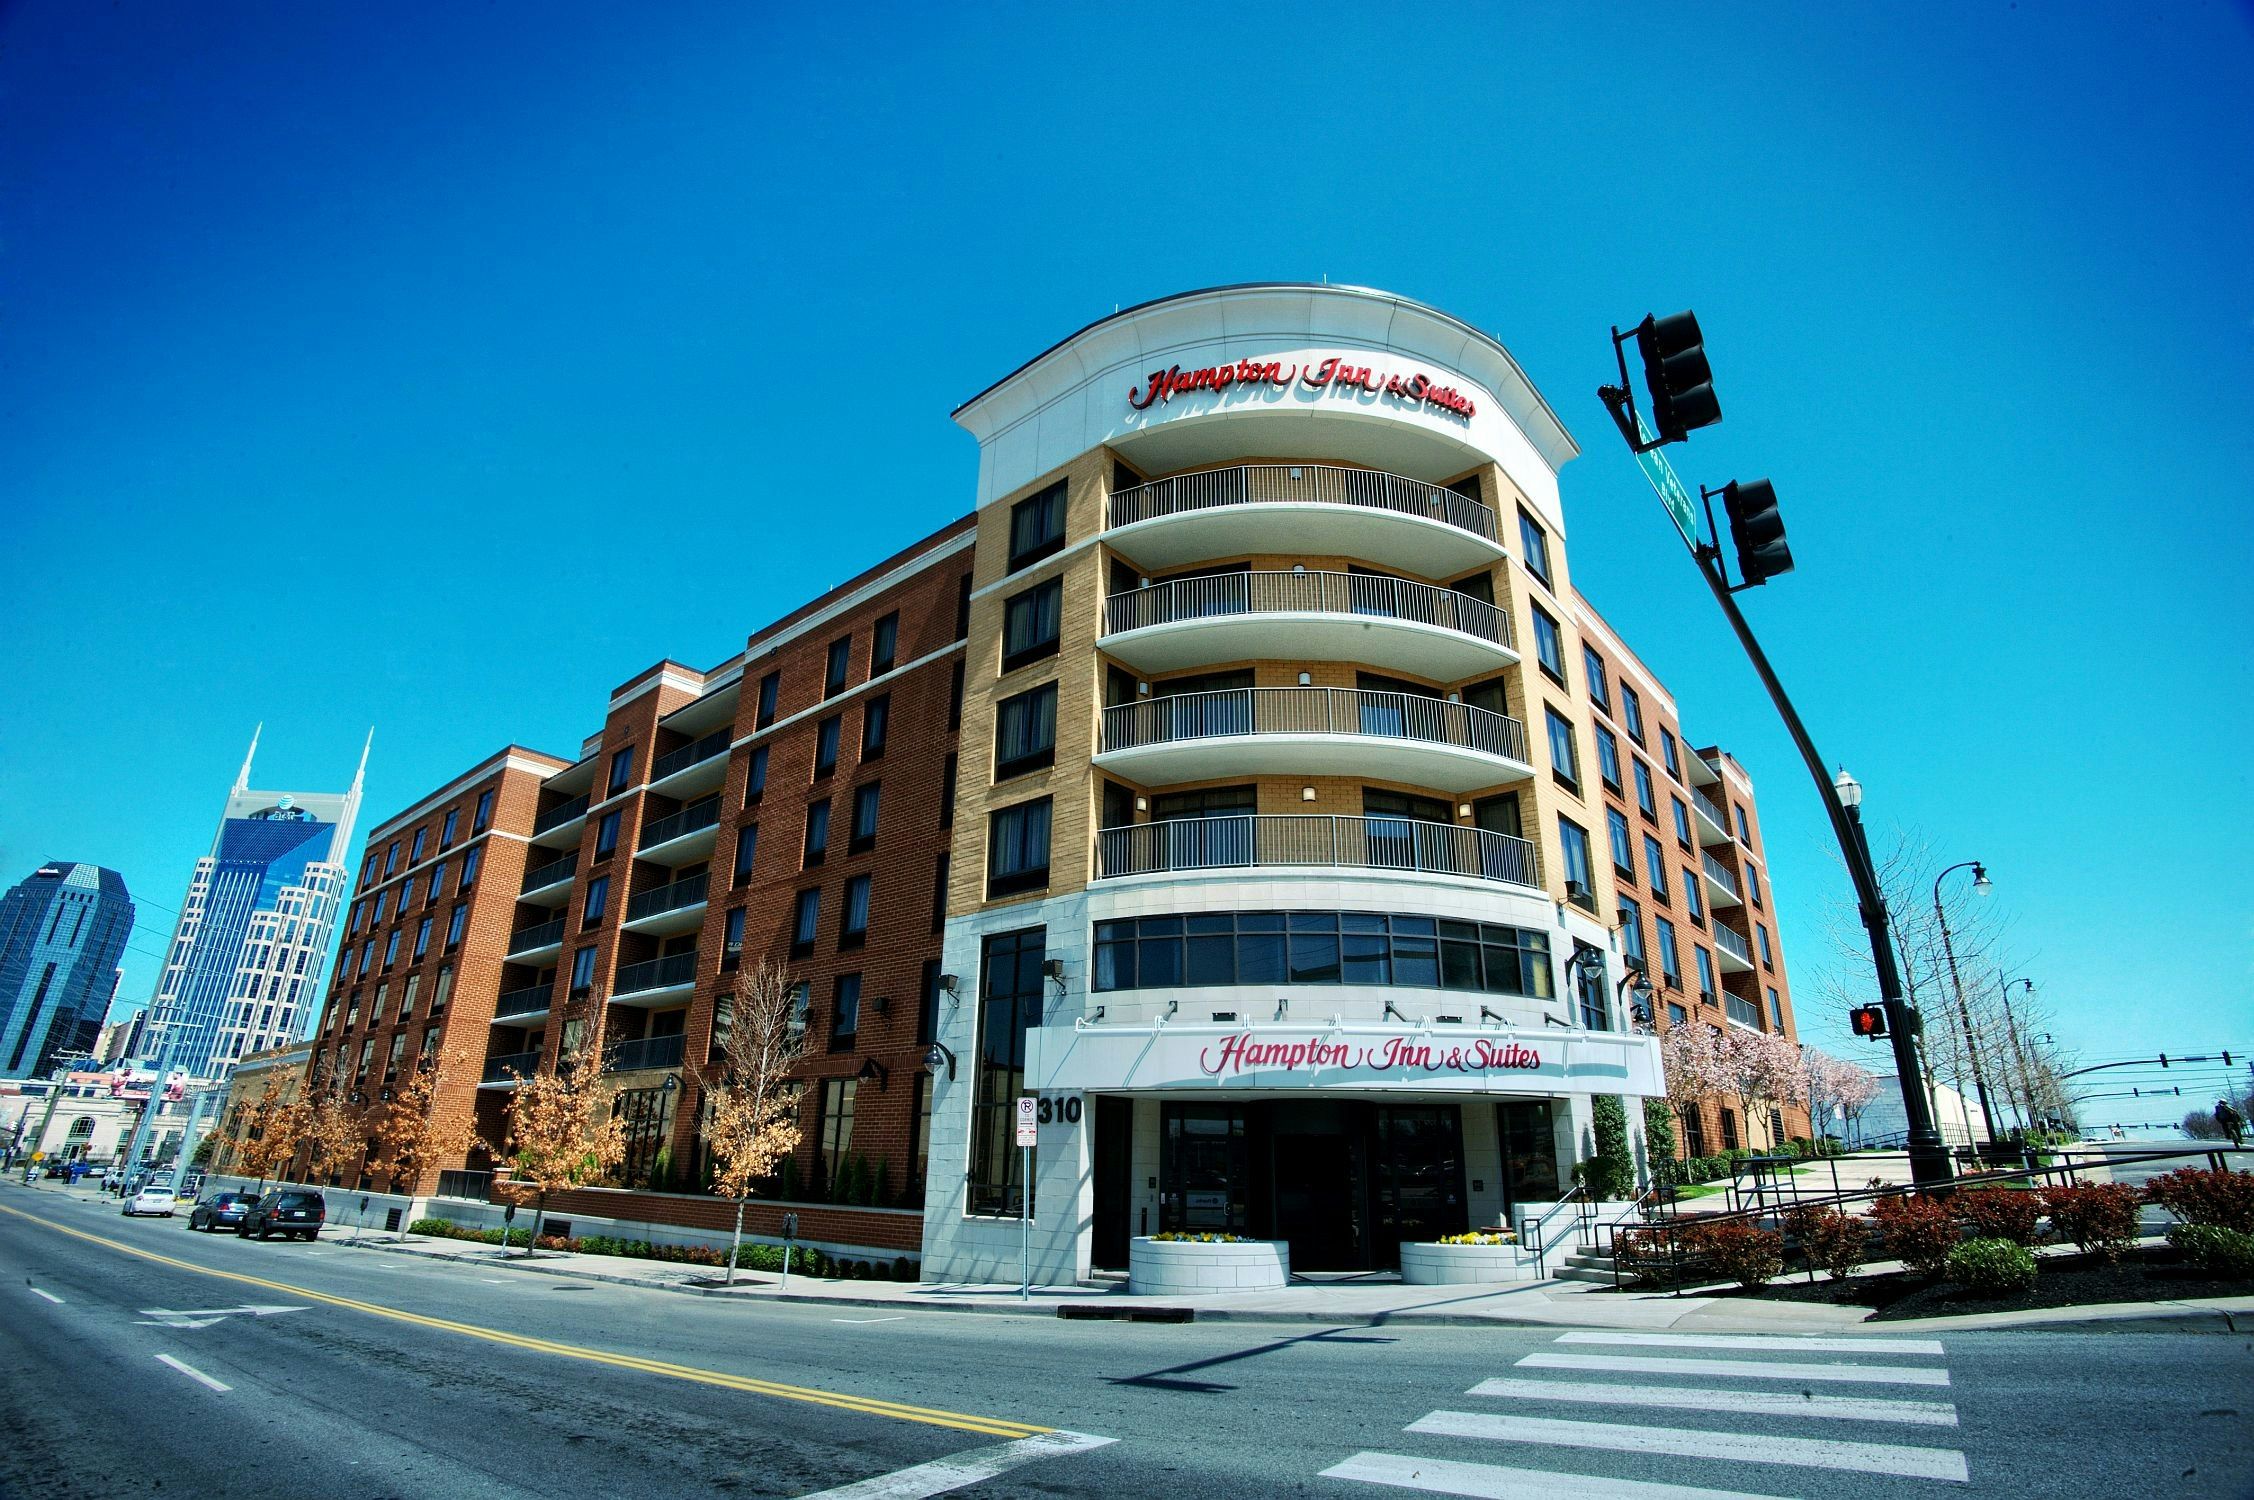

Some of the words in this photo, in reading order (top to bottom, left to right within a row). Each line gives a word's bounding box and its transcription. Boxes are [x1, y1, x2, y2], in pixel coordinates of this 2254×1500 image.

[1128, 358, 1296, 410] Hampton
[1303, 357, 1386, 391] Inn
[1402, 372, 1477, 418] Suites
[1661, 481, 1675, 512] Blvd
[1665, 466, 1694, 526] Veterans
[1200, 1033, 1363, 1074] Hampton
[1367, 1037, 1444, 1072] Inn
[1446, 1046, 1468, 1073] &
[1465, 1039, 1541, 1070] Suites
[1037, 1096, 1081, 1124] 310
